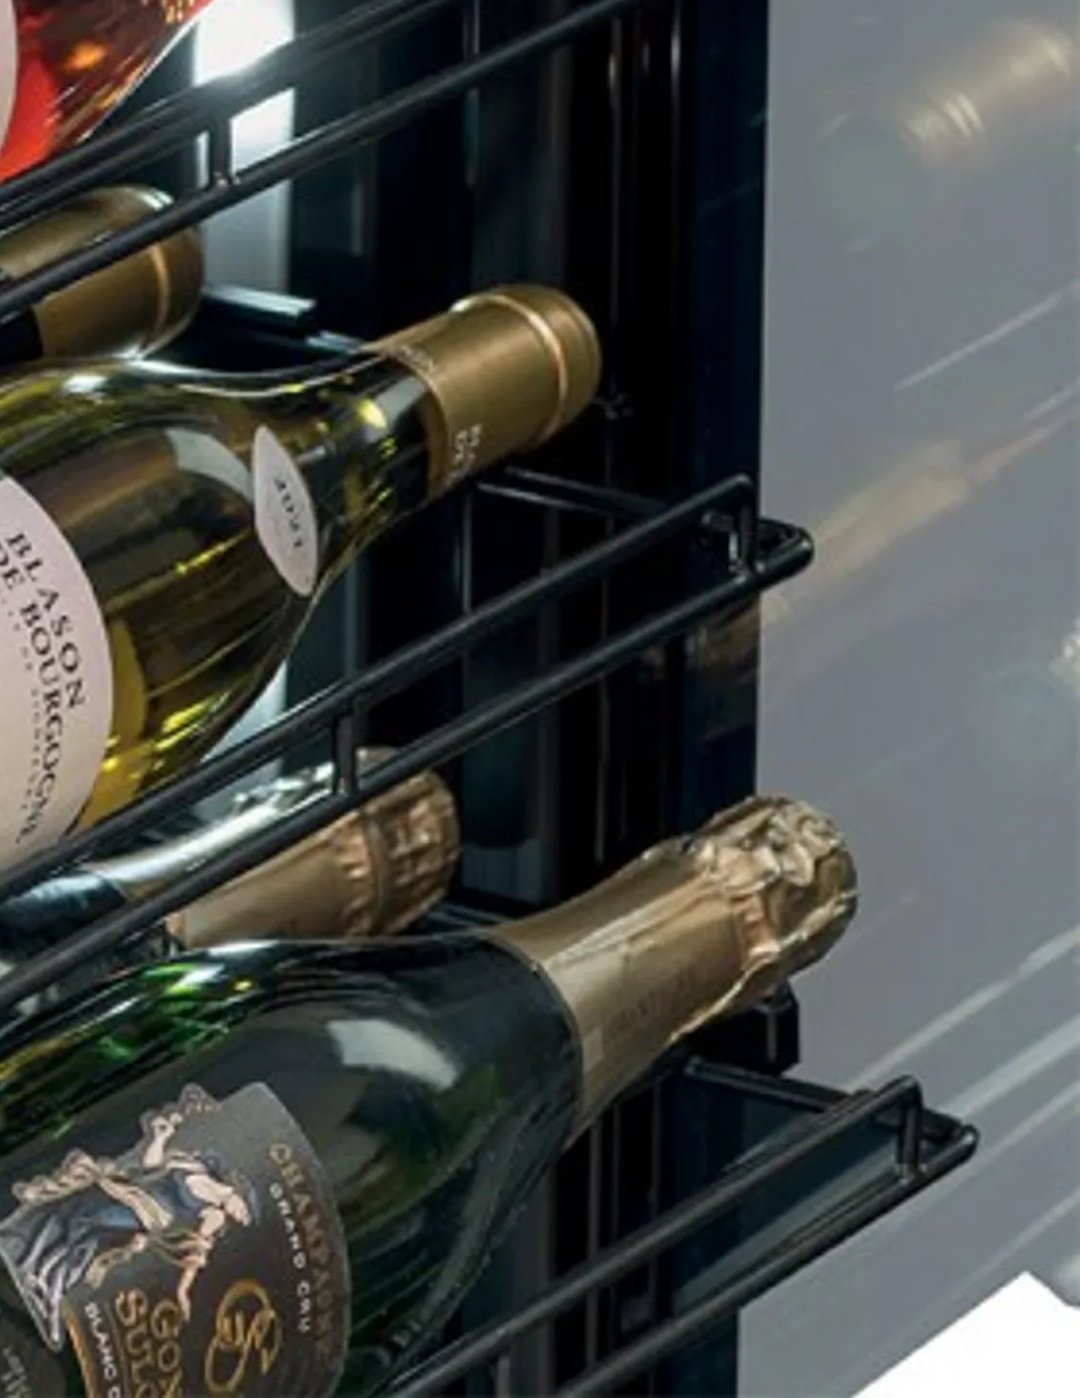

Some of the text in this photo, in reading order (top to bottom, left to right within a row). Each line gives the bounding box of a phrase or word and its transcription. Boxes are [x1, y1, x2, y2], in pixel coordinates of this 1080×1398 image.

[5, 530, 88, 711] BLASON
[15, 602, 68, 846] BOURGOGNE
[84, 1302, 118, 1380] BLANC
[269, 1182, 311, 1334] GRAND CRU
